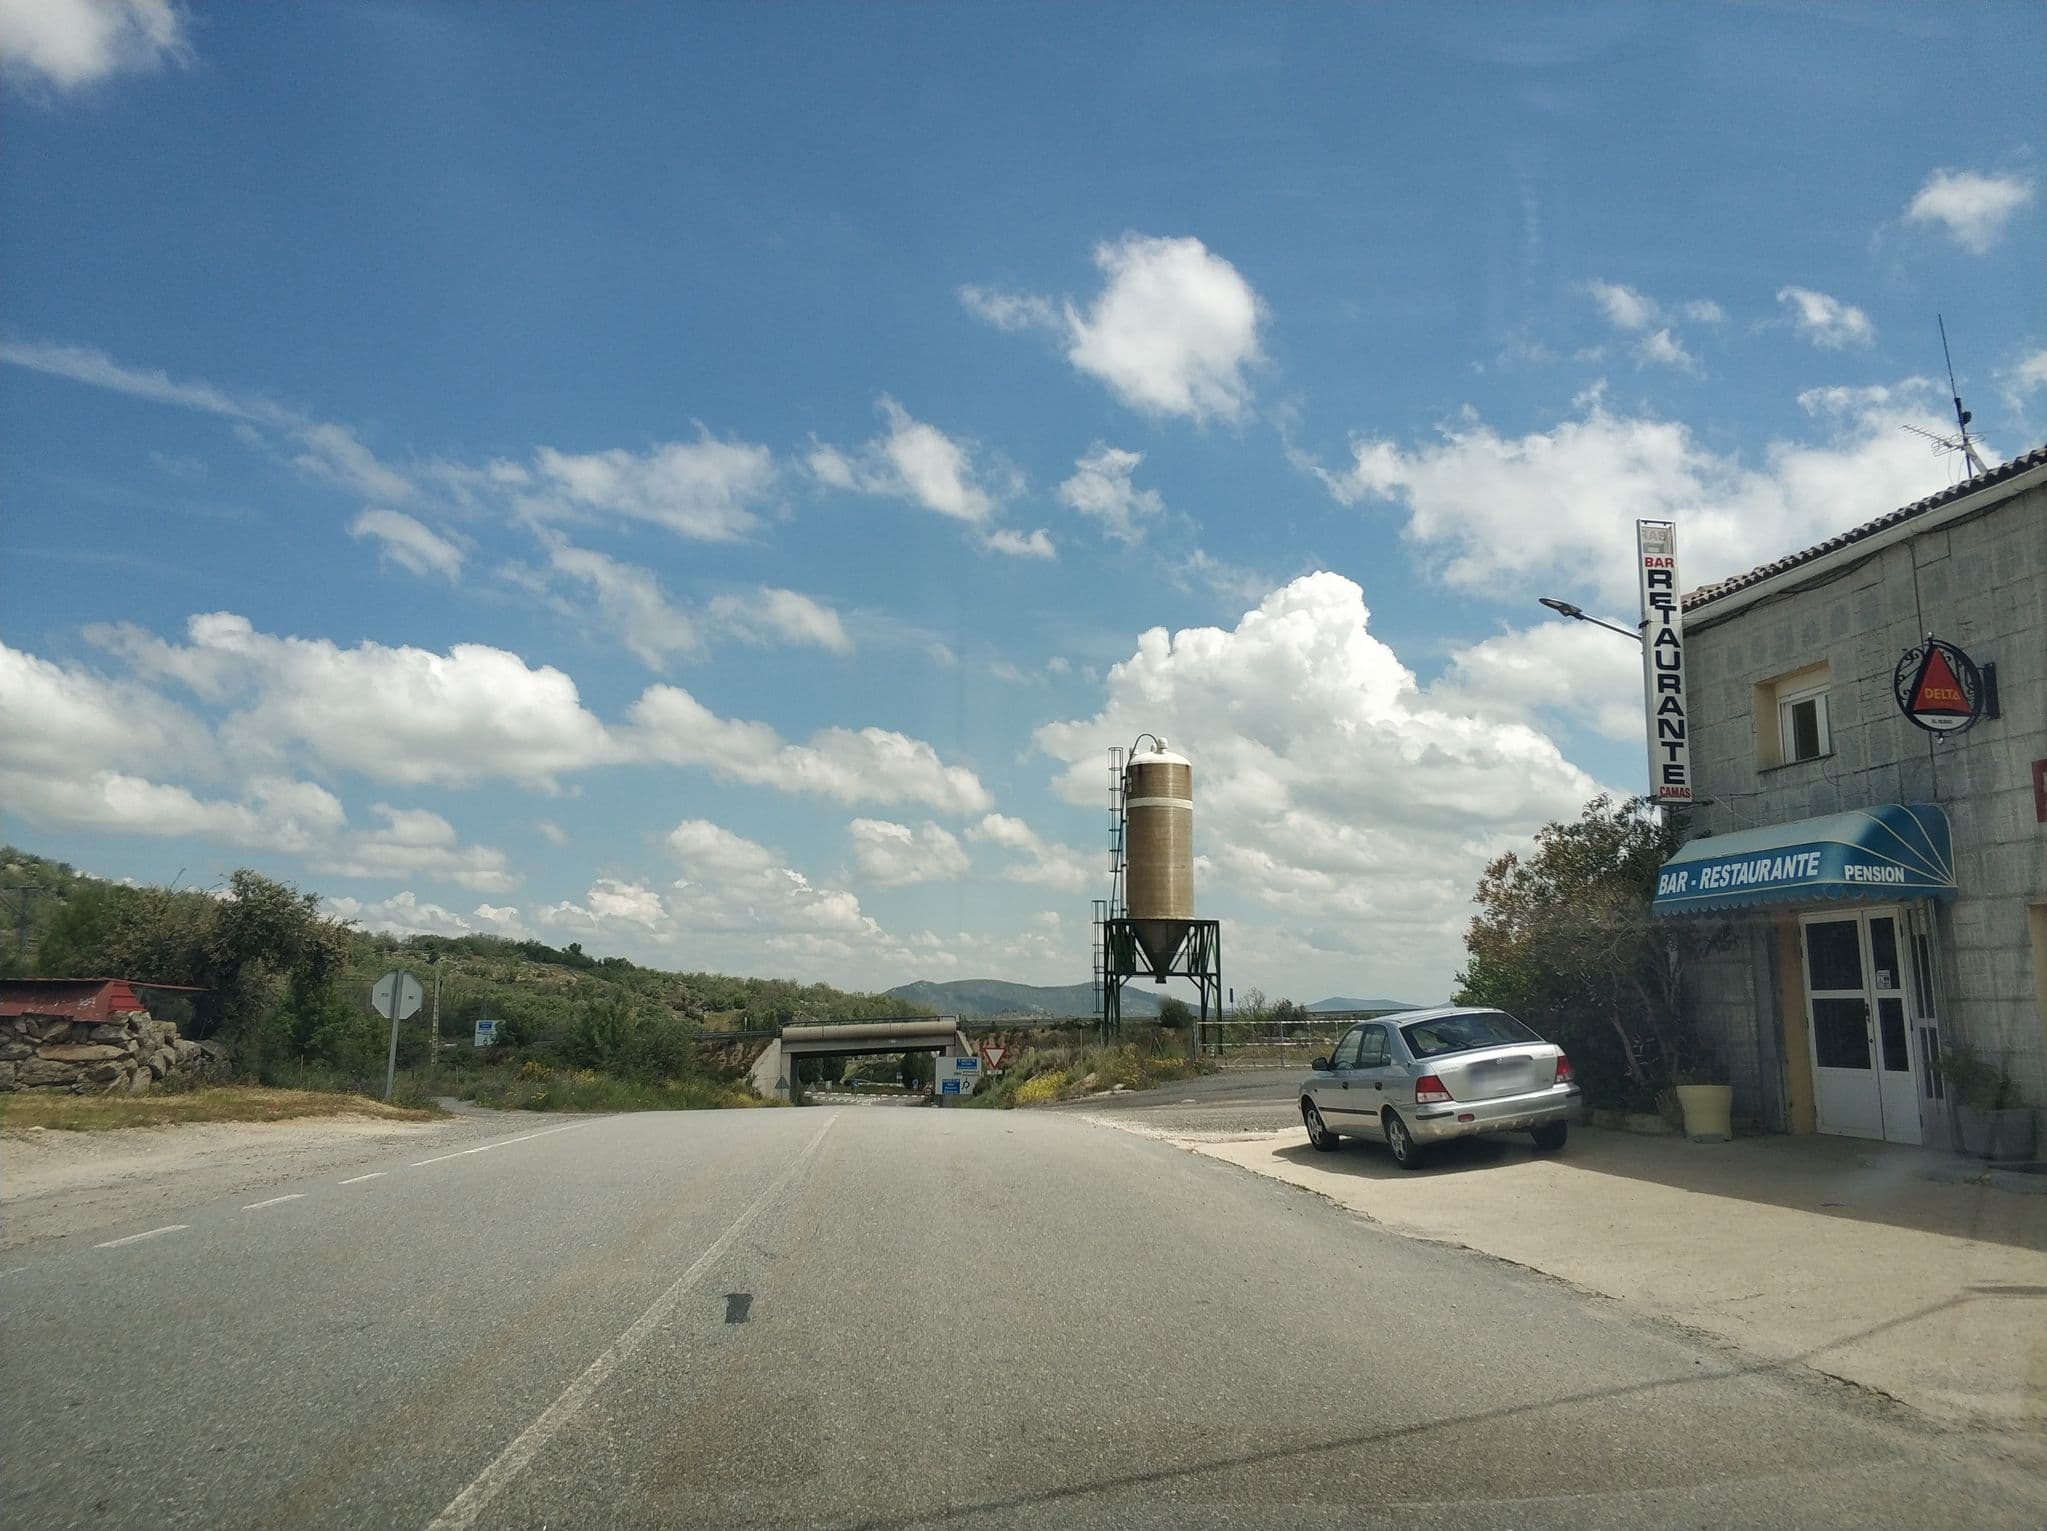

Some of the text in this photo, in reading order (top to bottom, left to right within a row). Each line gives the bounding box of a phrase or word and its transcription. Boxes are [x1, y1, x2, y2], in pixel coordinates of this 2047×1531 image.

[1645, 557, 1674, 568] BAR
[1924, 687, 1960, 700] DELTA
[1660, 786, 1691, 798] CAMAS
[1658, 871, 1688, 896] BAR
[1699, 851, 1821, 890] RESTAURANTE
[1844, 864, 1905, 883] PENSION
